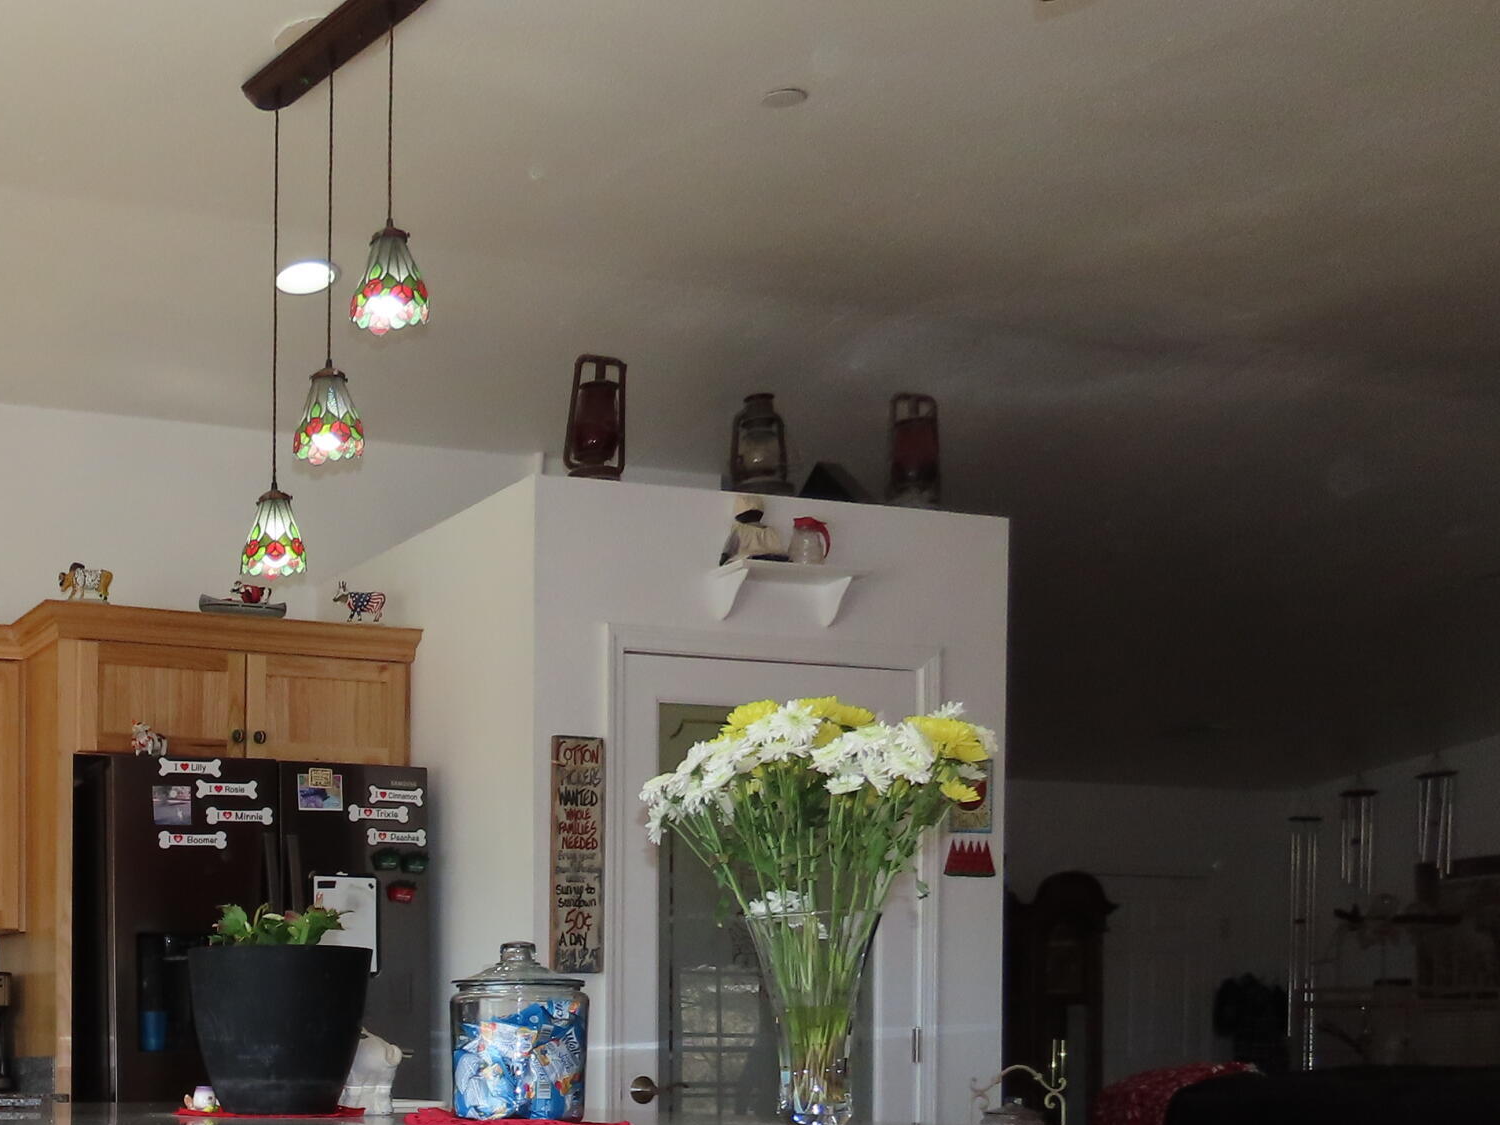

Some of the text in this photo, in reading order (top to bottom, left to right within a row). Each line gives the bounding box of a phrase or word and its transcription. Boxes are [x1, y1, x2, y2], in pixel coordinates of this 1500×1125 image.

[555, 740, 600, 767] COTTON
[190, 763, 207, 773] Lilly
[224, 785, 245, 794] Rosie
[388, 792, 418, 801] Cinnamon
[558, 787, 598, 807] WANTED
[234, 812, 263, 821] Minnie
[375, 809, 399, 818] Trixie
[186, 835, 218, 844] Boomer
[561, 834, 599, 850] NEEDED
[565, 908, 593, 934] 50¢
[558, 931, 588, 949] A DAY
